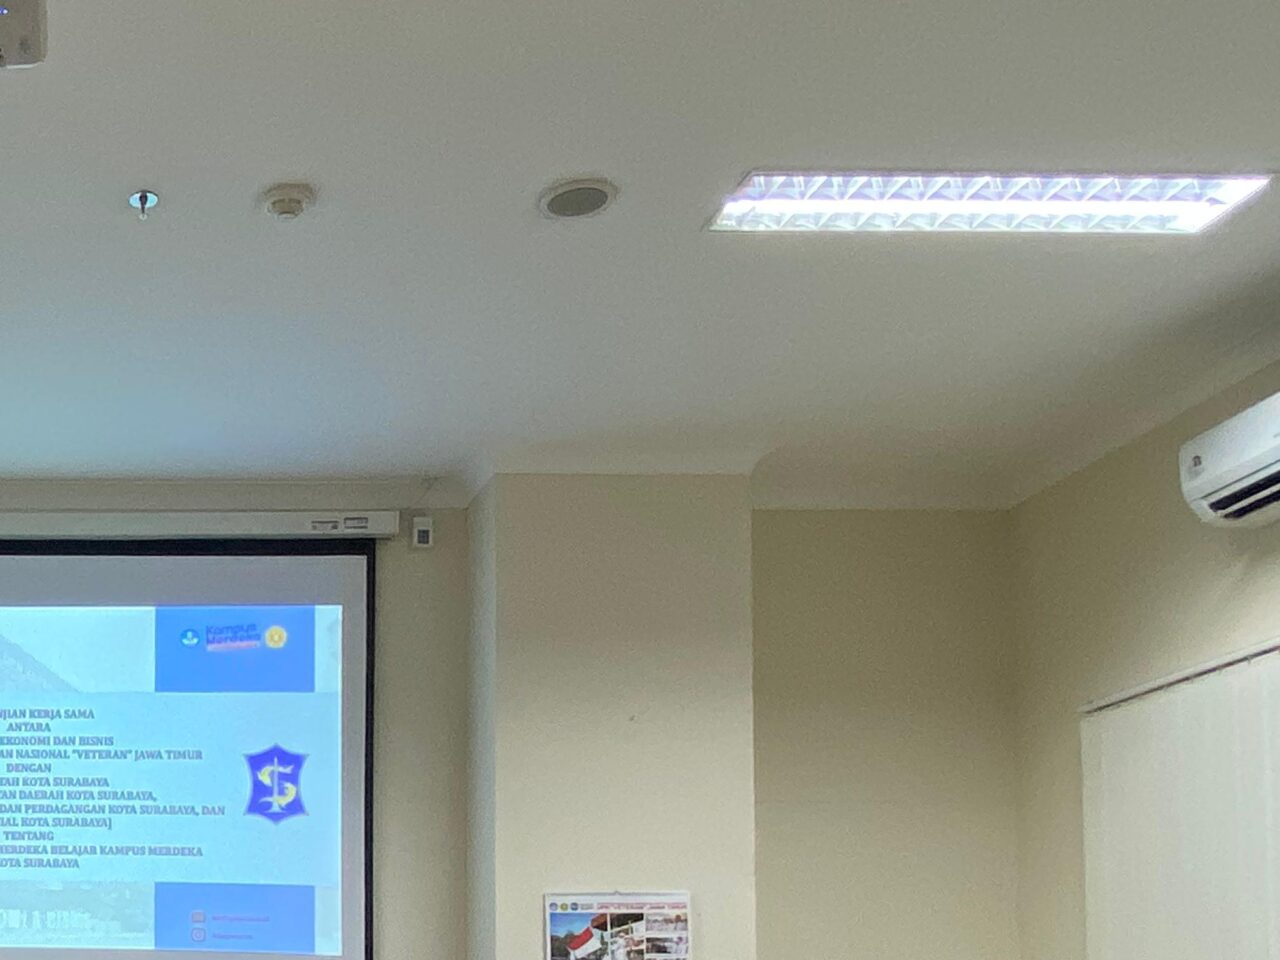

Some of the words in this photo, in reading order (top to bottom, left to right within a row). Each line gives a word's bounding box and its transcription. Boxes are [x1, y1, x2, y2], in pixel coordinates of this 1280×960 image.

[29, 709, 62, 720] KERJA
[64, 709, 95, 719] SAMA
[6, 722, 52, 732] ANTARA
[0, 736, 51, 746] EKONOMI
[53, 736, 76, 746] DAN
[78, 736, 114, 746] BISNIS
[15, 749, 70, 759] NASIONAL
[134, 750, 163, 761] JAWA
[165, 750, 203, 760] TIMUR
[6, 763, 52, 773] DENGAN
[22, 777, 51, 787] KOTA
[53, 778, 110, 787] SURABAYA
[19, 790, 64, 800] DAERAH
[66, 791, 95, 800] KOTA
[97, 791, 157, 802] SURABAYA,
[0, 804, 22, 814] DAN
[24, 804, 106, 814] PERDAGANGAN
[108, 805, 137, 815] KOTA
[140, 805, 200, 816] SURABAYA,
[202, 806, 226, 816] DAN
[21, 817, 50, 827] KOTA
[3, 831, 54, 841] TENTANG
[50, 846, 97, 856] BELAJAR
[99, 846, 146, 856] KAMPUS
[148, 846, 203, 856] MERDEKA
[24, 858, 79, 868] SURABAYA
